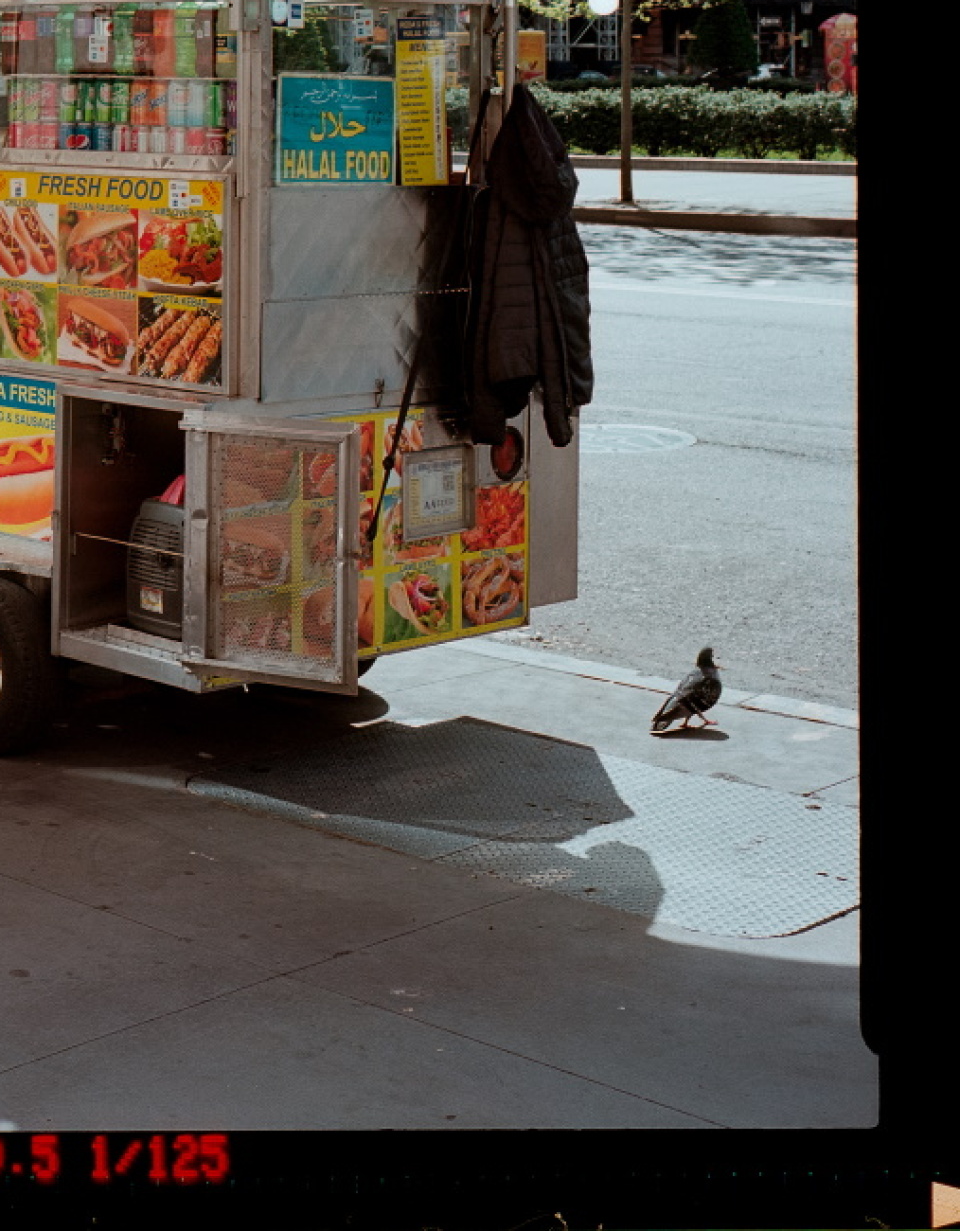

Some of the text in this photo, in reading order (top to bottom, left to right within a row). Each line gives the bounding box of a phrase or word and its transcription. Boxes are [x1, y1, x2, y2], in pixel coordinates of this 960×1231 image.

[309, 110, 367, 143] حلال
[283, 148, 390, 180] HALAL FOOD
[37, 175, 164, 201] FRESH FOOD
[9, 383, 56, 408] FRESH
